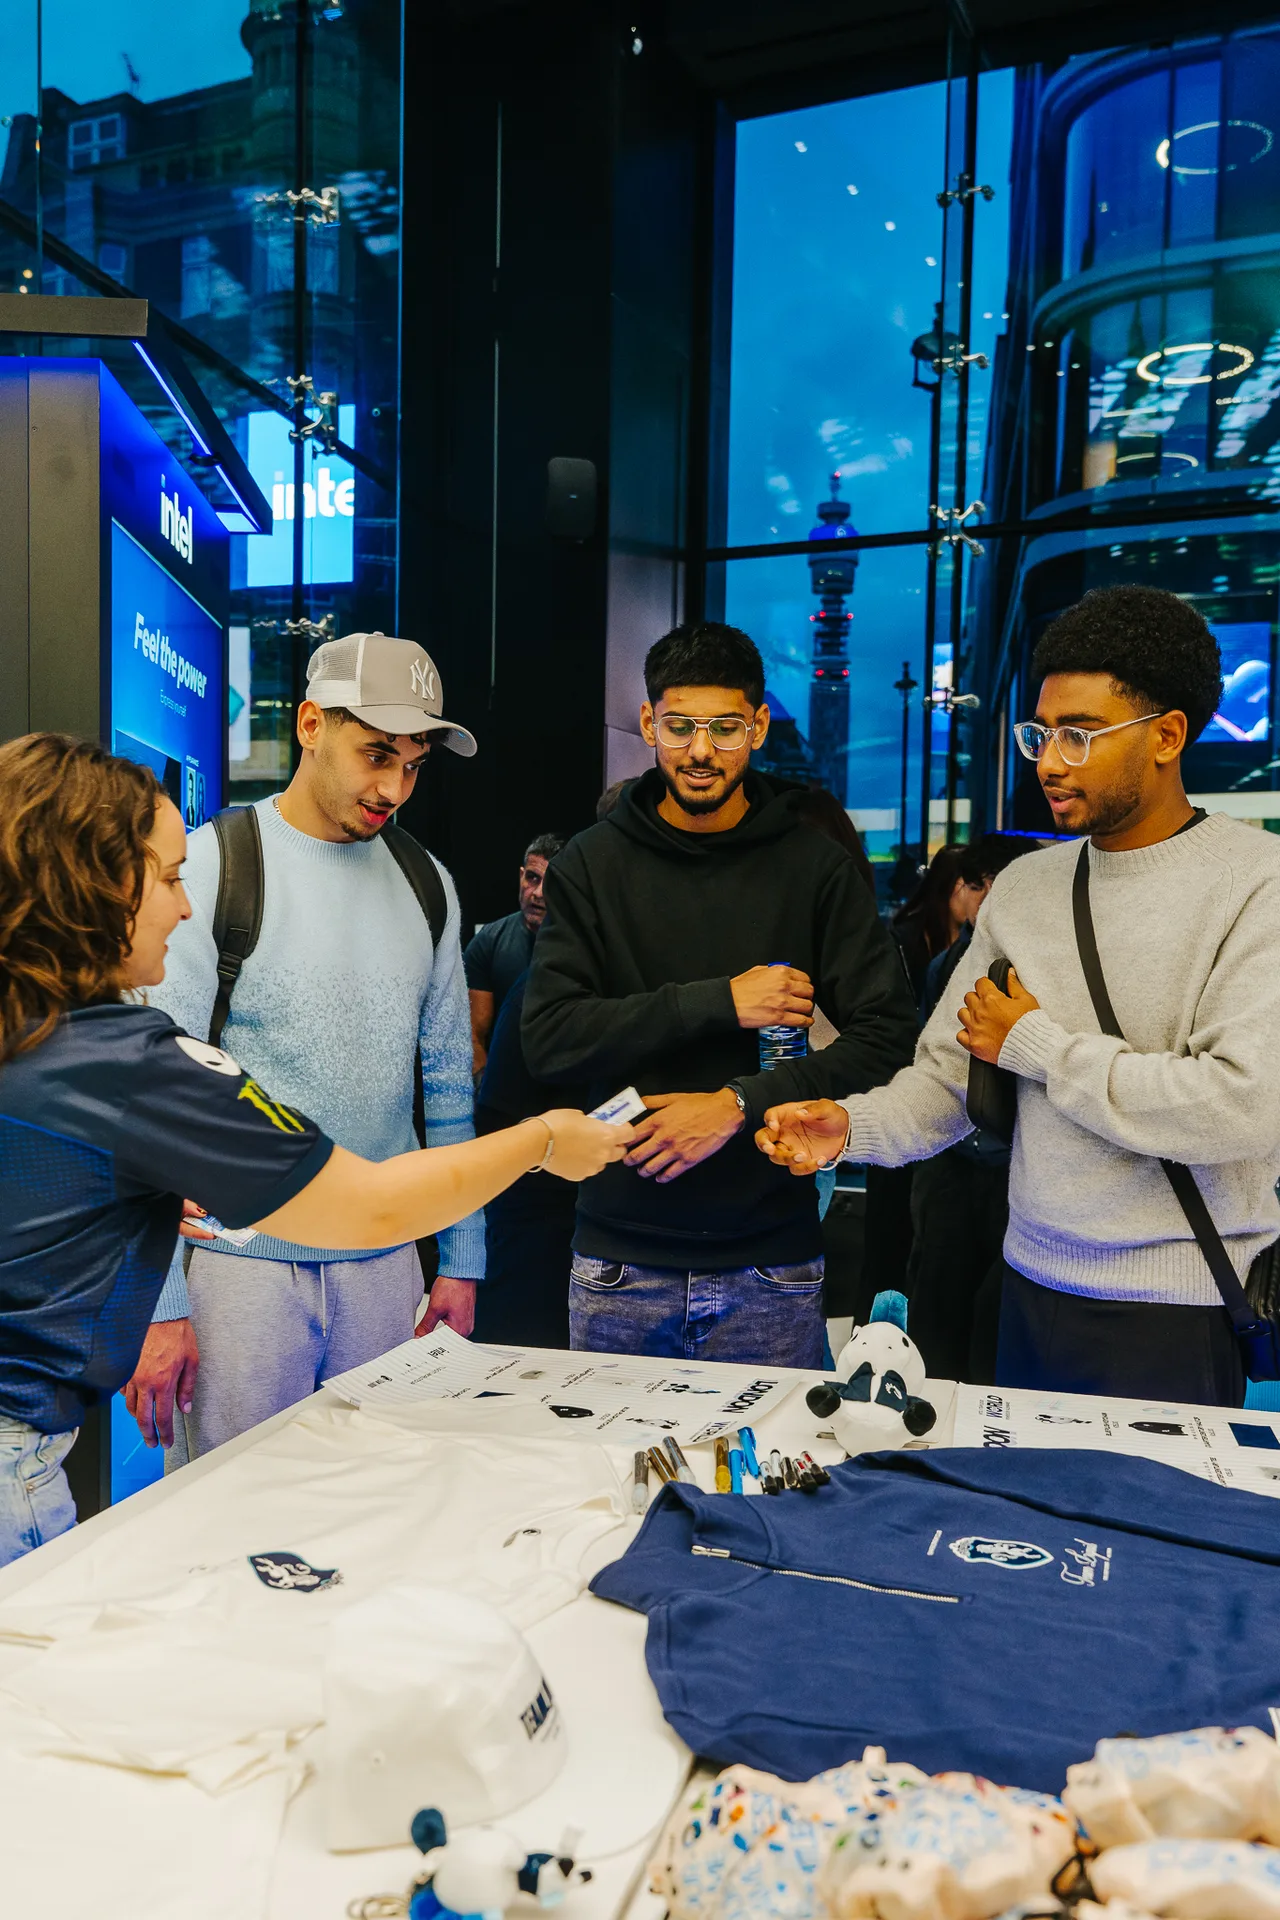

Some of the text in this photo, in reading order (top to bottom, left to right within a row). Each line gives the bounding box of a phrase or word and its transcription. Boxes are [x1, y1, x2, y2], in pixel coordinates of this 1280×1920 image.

[161, 473, 193, 565] intel
[271, 466, 356, 520] inte
[134, 611, 208, 699] Feel the power
[410, 658, 436, 702] NY
[721, 1380, 779, 1414] LONDON
